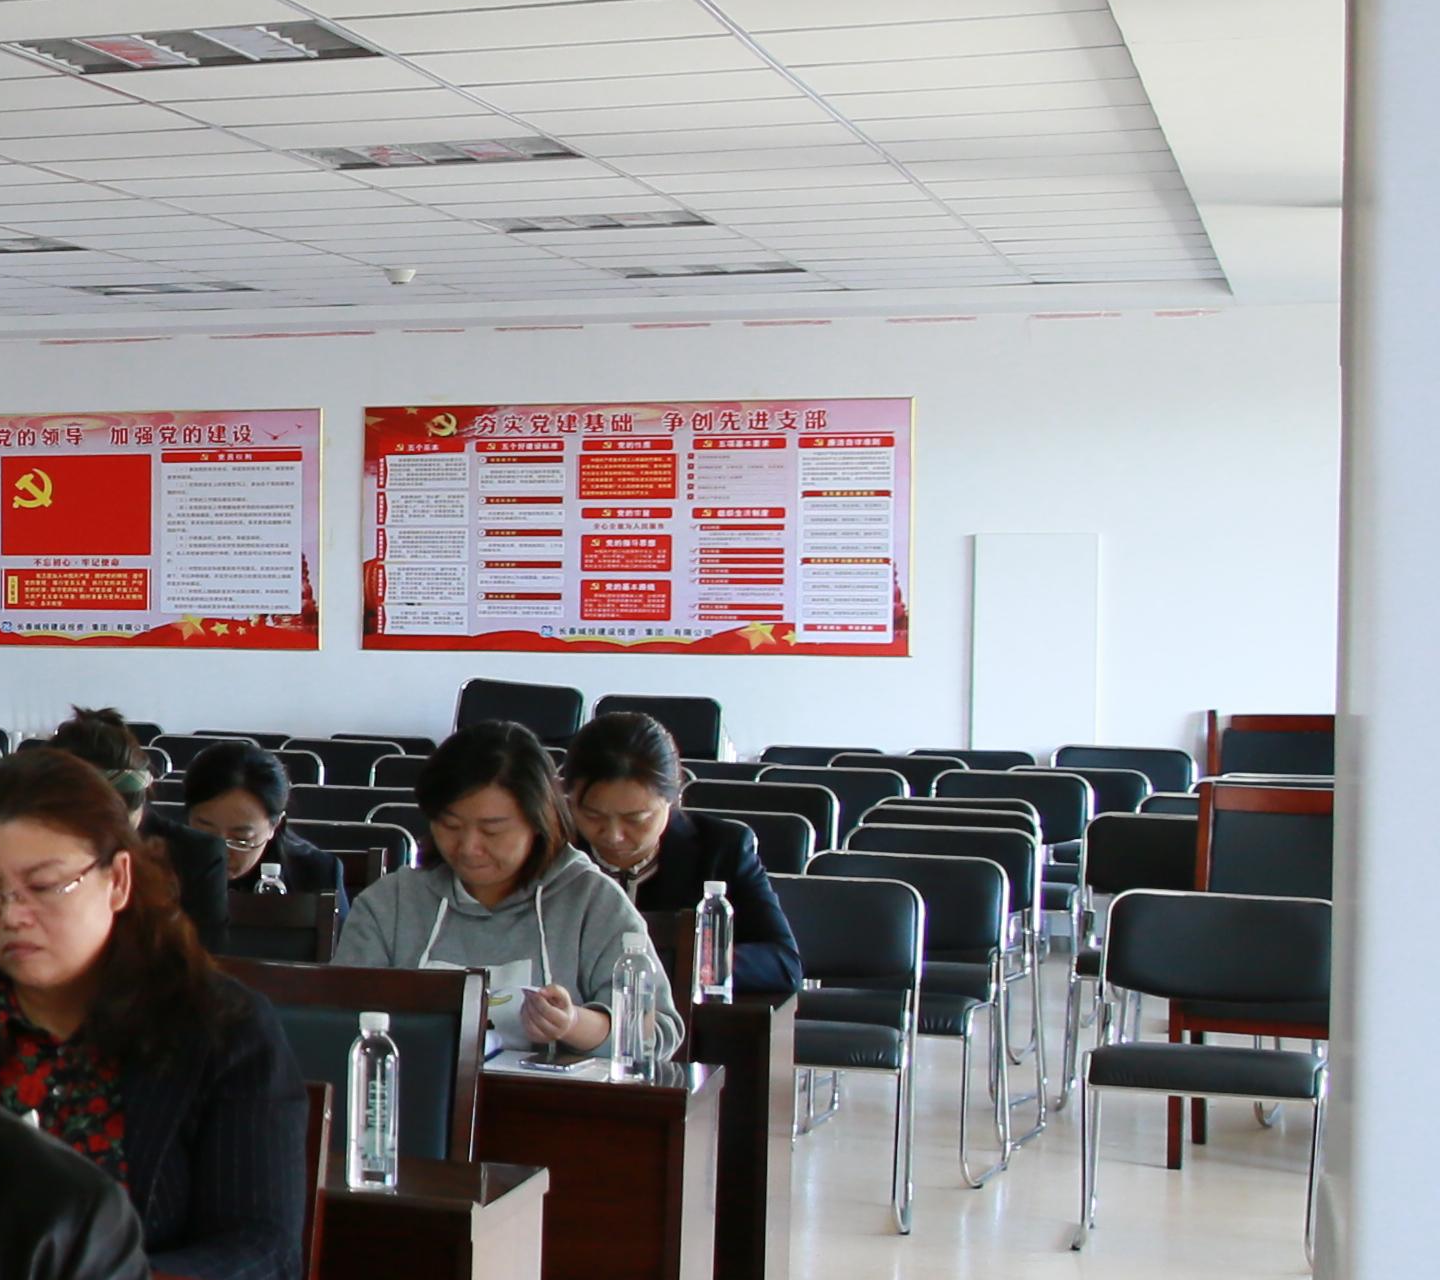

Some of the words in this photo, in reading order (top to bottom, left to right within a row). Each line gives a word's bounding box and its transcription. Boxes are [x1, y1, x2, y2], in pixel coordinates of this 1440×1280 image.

[477, 412, 633, 434] 夯实党建基础
[663, 409, 828, 431] 争创先进支部
[110, 424, 253, 446] 加强党的建设
